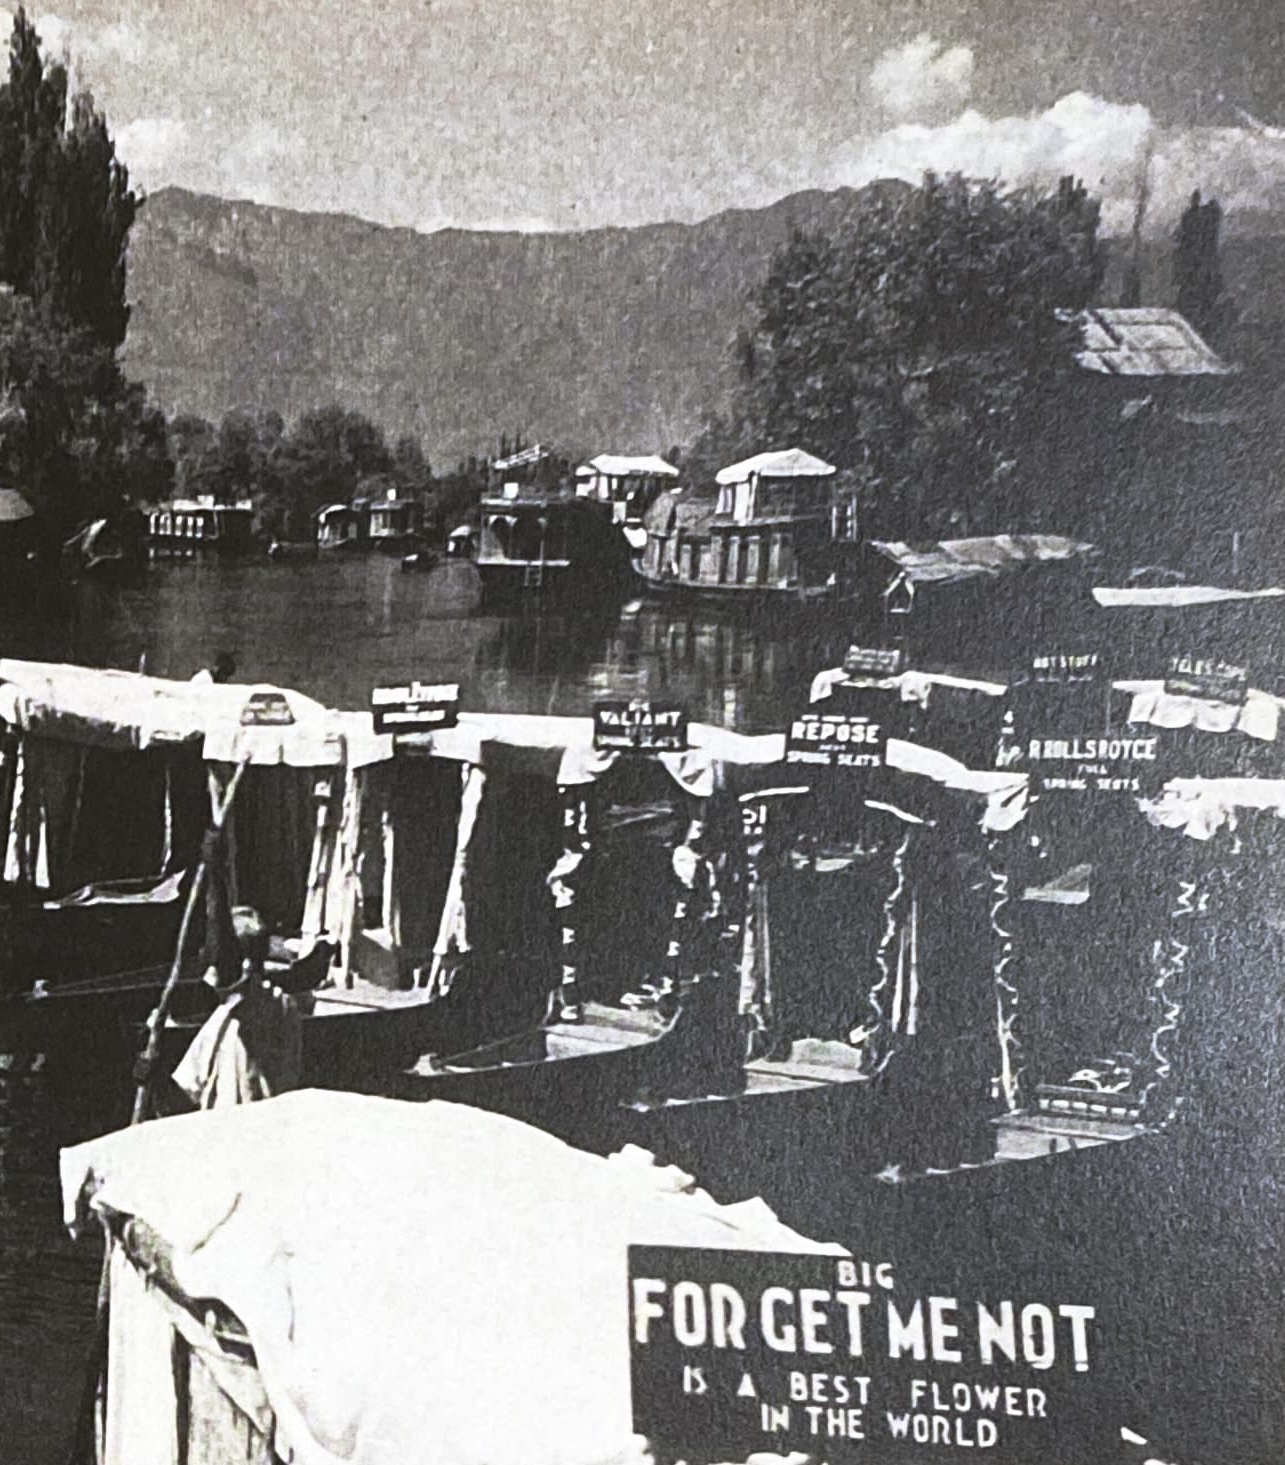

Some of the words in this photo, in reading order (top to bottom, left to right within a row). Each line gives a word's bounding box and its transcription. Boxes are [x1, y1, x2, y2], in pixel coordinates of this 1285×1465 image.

[599, 710, 682, 728] VALIANT
[791, 721, 881, 744] REPOSE
[837, 1260, 894, 1289] BIG
[886, 1296, 963, 1363] ME
[975, 1300, 1096, 1372] NOT
[683, 1365, 708, 1395] IS
[736, 1373, 757, 1397] A
[789, 1371, 872, 1405] BEST
[910, 1379, 1048, 1418] FLOWER
[760, 1403, 791, 1433] IN
[804, 1405, 866, 1440] THE
[885, 1410, 999, 1449] WORLD
